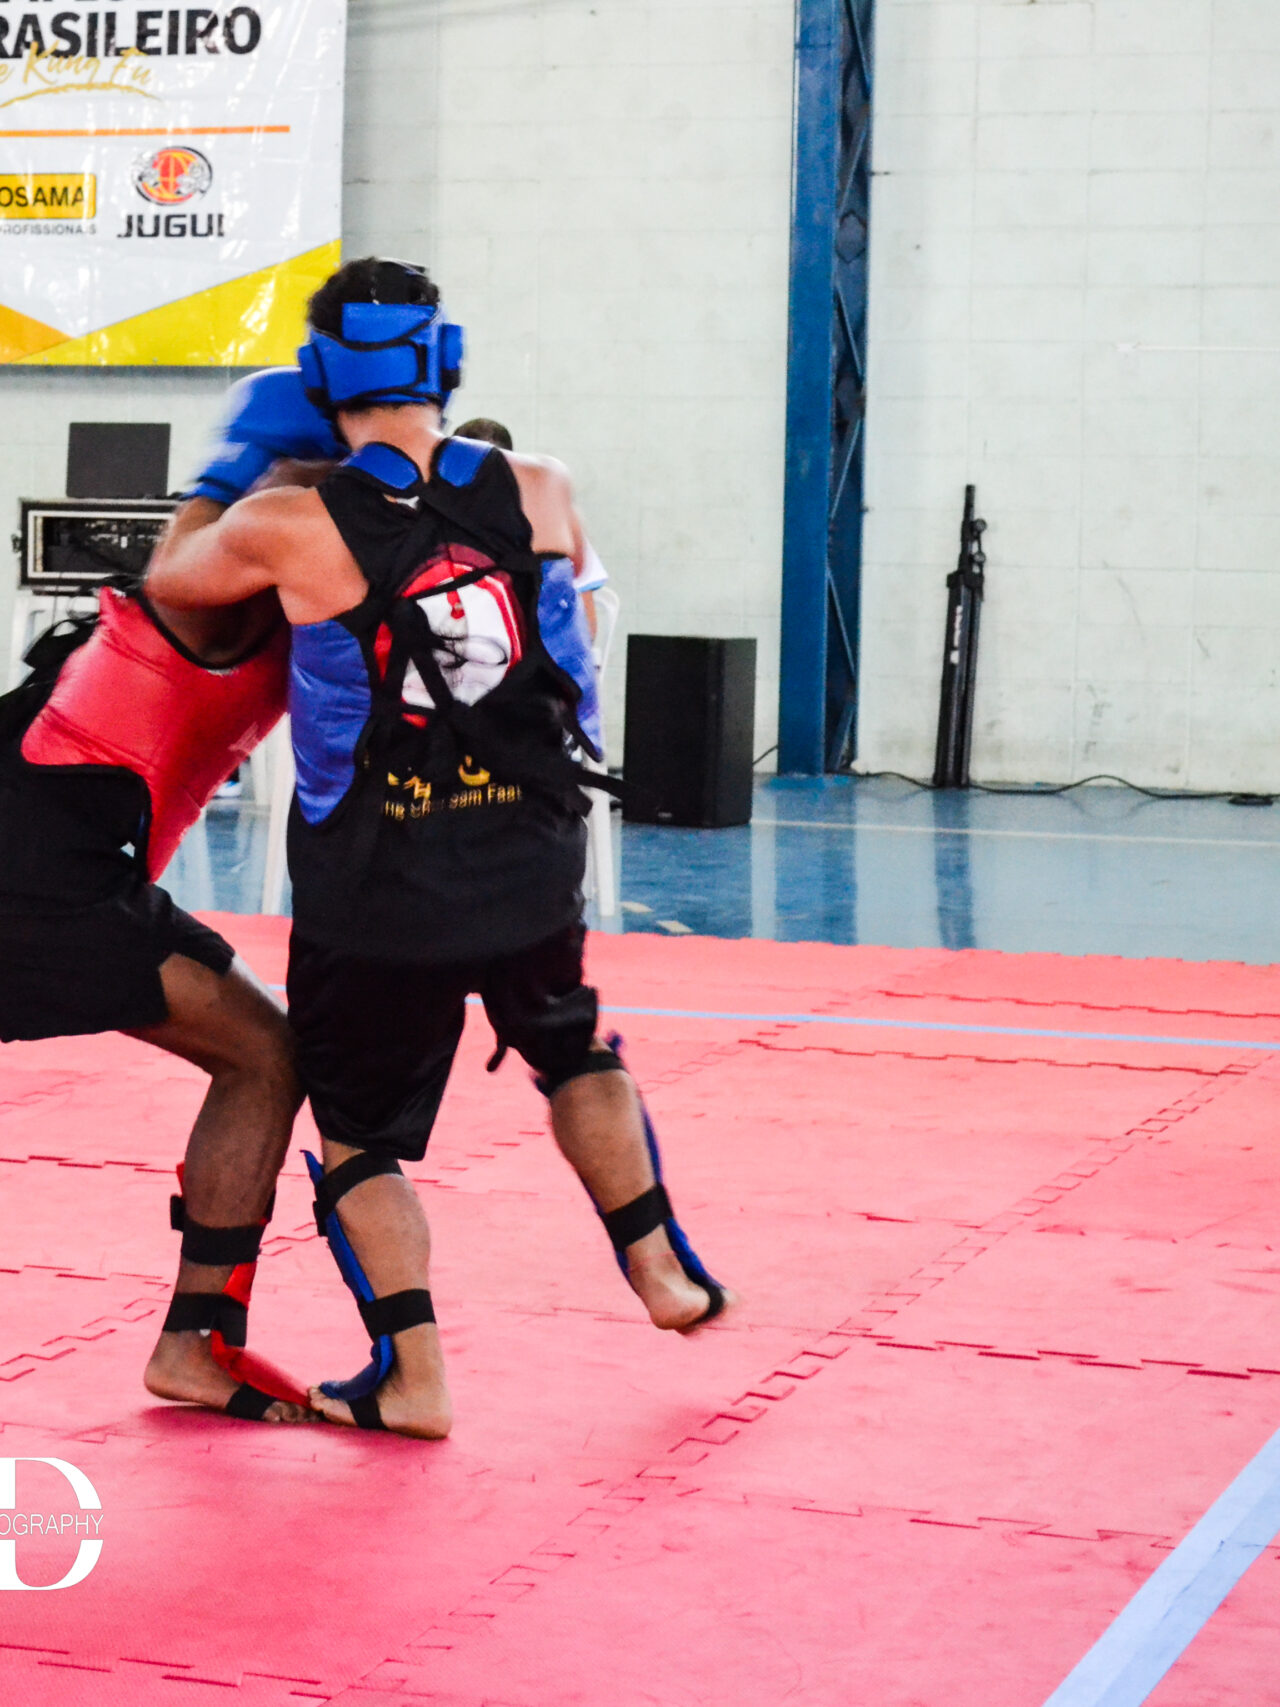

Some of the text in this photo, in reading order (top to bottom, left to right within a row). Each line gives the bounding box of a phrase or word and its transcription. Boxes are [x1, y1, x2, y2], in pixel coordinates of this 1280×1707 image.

[22, 39, 101, 84] Kung
[108, 46, 153, 85] Fu
[116, 213, 224, 238] JUGUI
